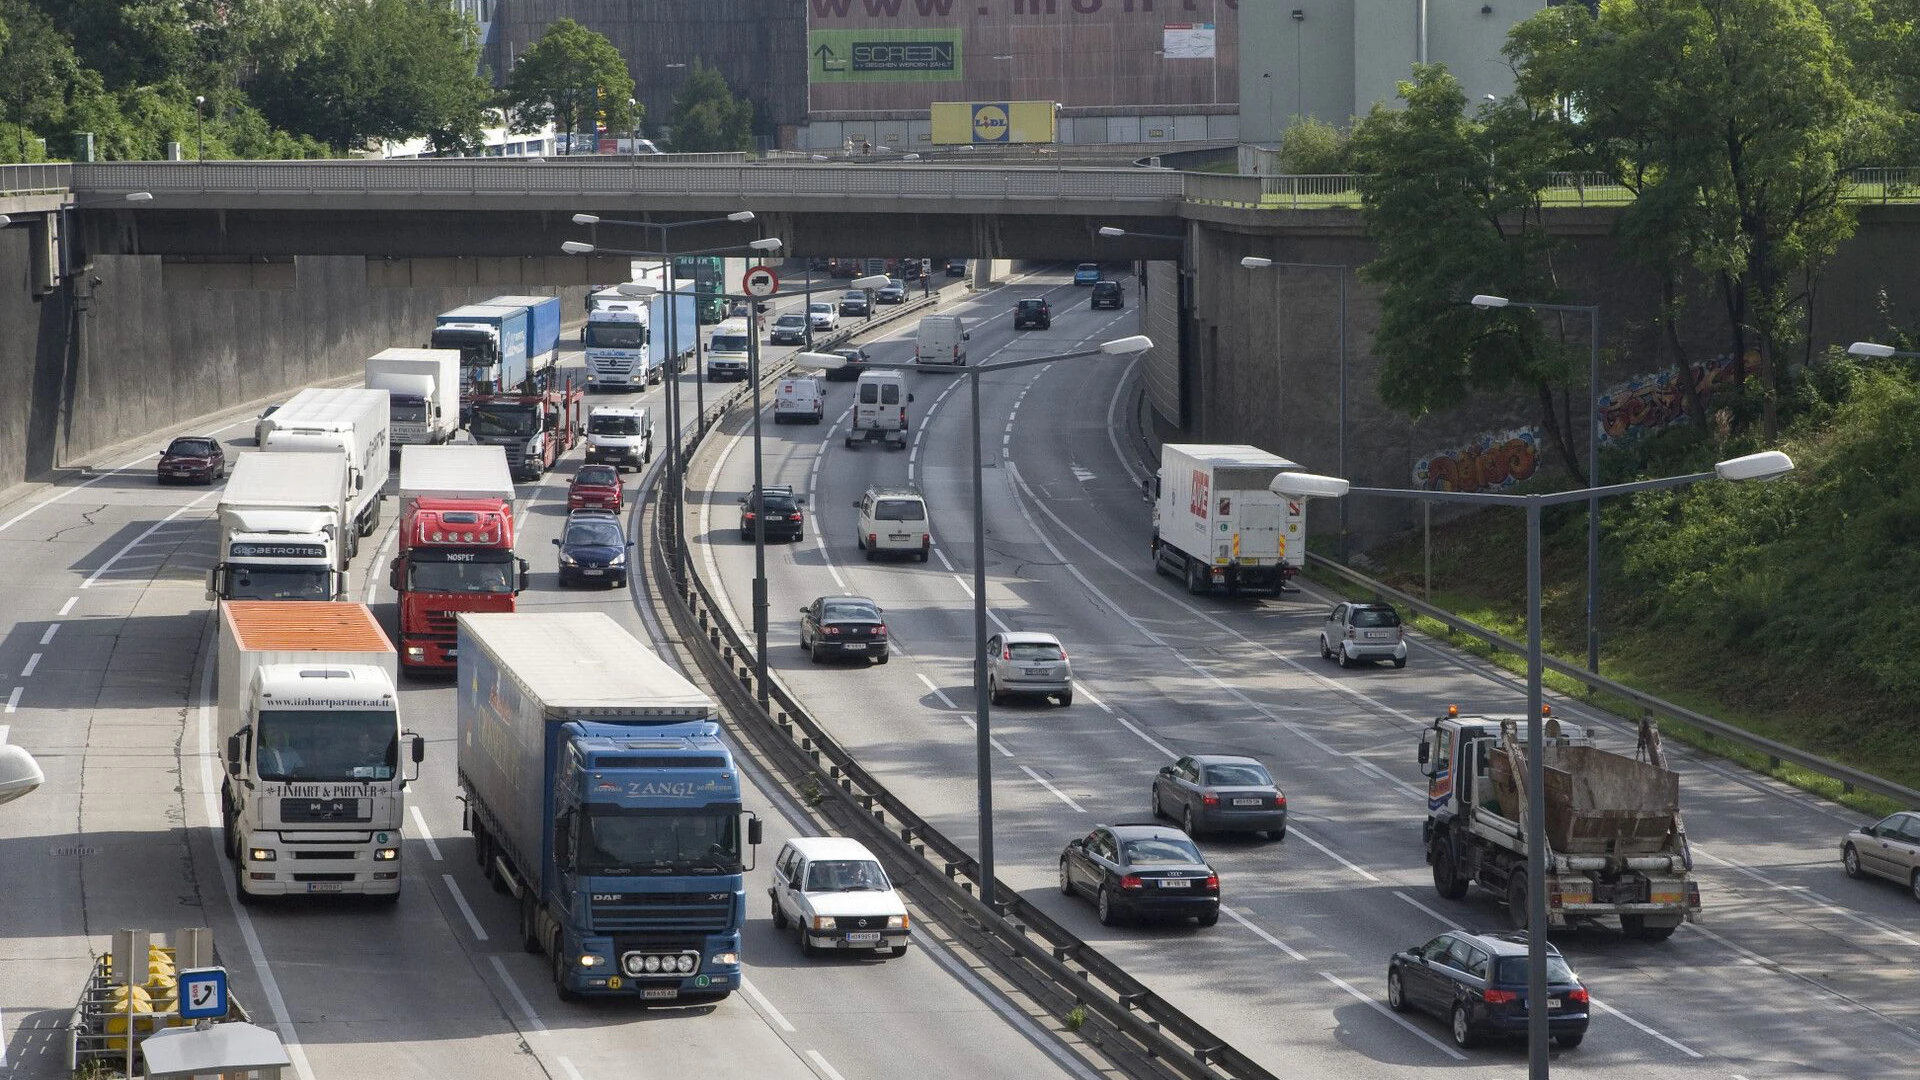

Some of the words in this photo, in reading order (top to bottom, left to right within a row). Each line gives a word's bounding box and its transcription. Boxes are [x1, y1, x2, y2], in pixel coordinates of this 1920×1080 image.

[233, 547, 323, 556] GLOBETROTTER
[322, 786, 331, 797] &
[333, 786, 377, 797] PARTNER
[628, 781, 695, 796] ZANGL
